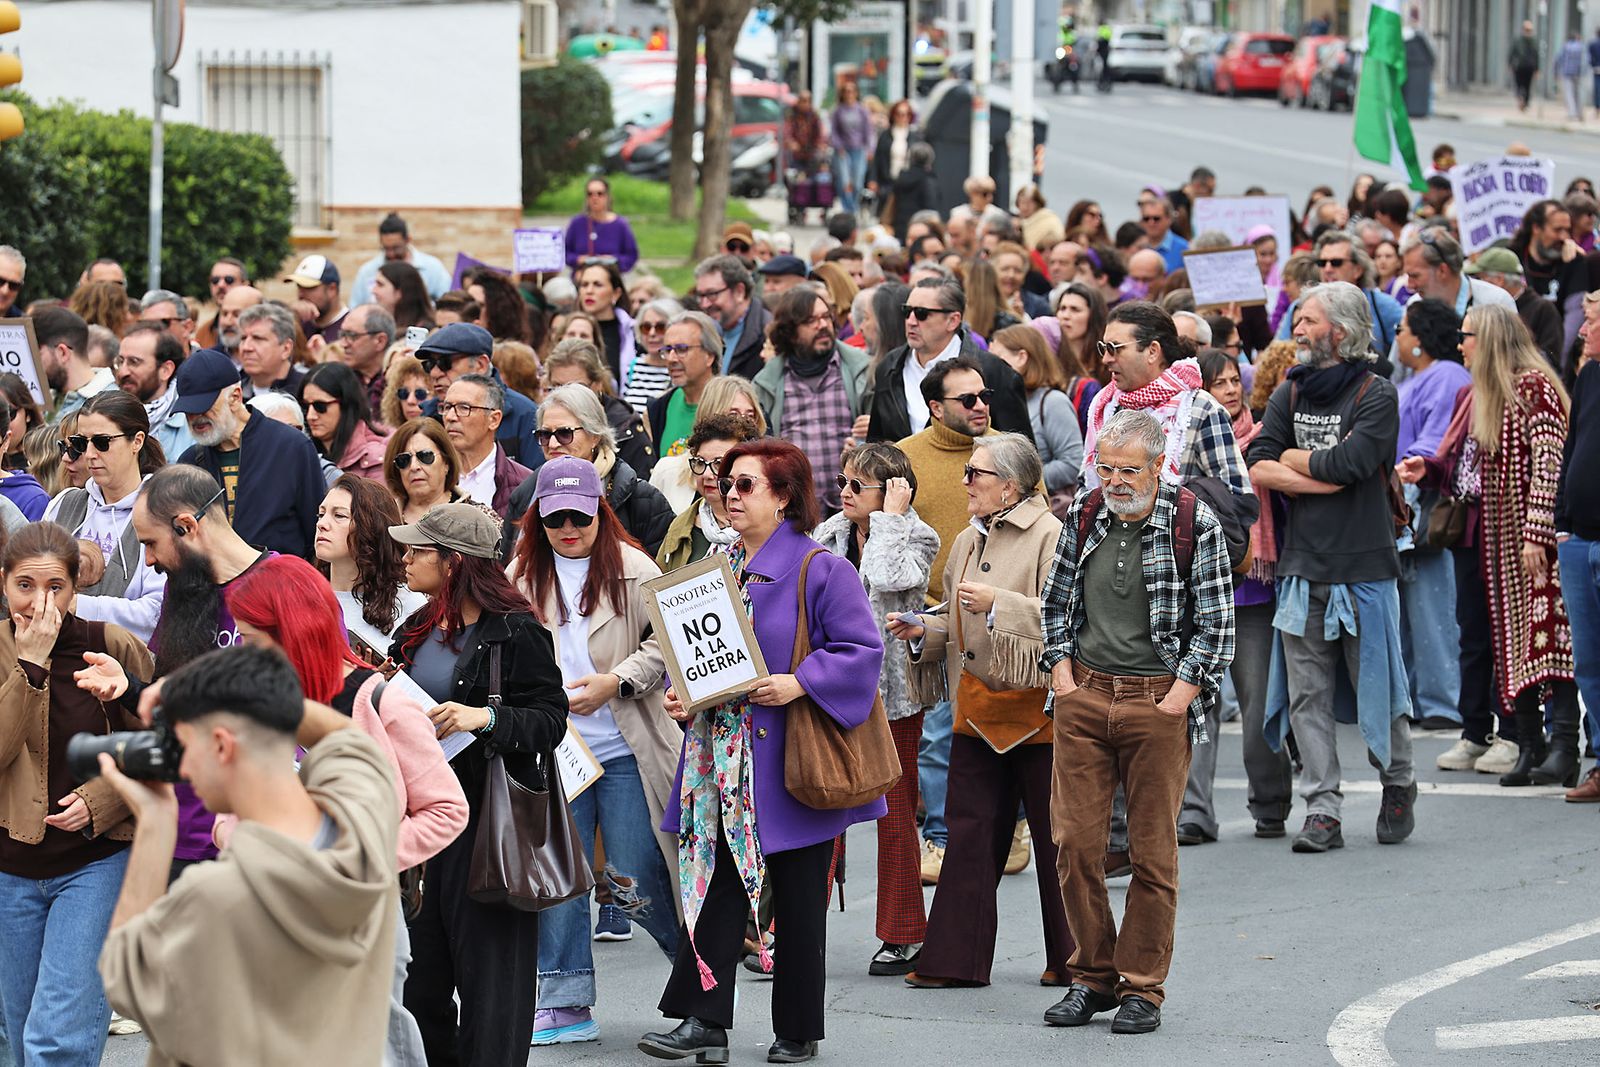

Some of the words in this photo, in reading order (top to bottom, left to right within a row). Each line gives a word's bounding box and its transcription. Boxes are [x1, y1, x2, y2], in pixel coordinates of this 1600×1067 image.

[1504, 172, 1516, 192] EL
[554, 477, 580, 488] FEMINIST
[660, 578, 724, 611] NOSOTRAS
[682, 612, 721, 645] NO
[695, 646, 705, 660] A
[708, 637, 727, 654] LA
[686, 649, 747, 682] GUERRA
